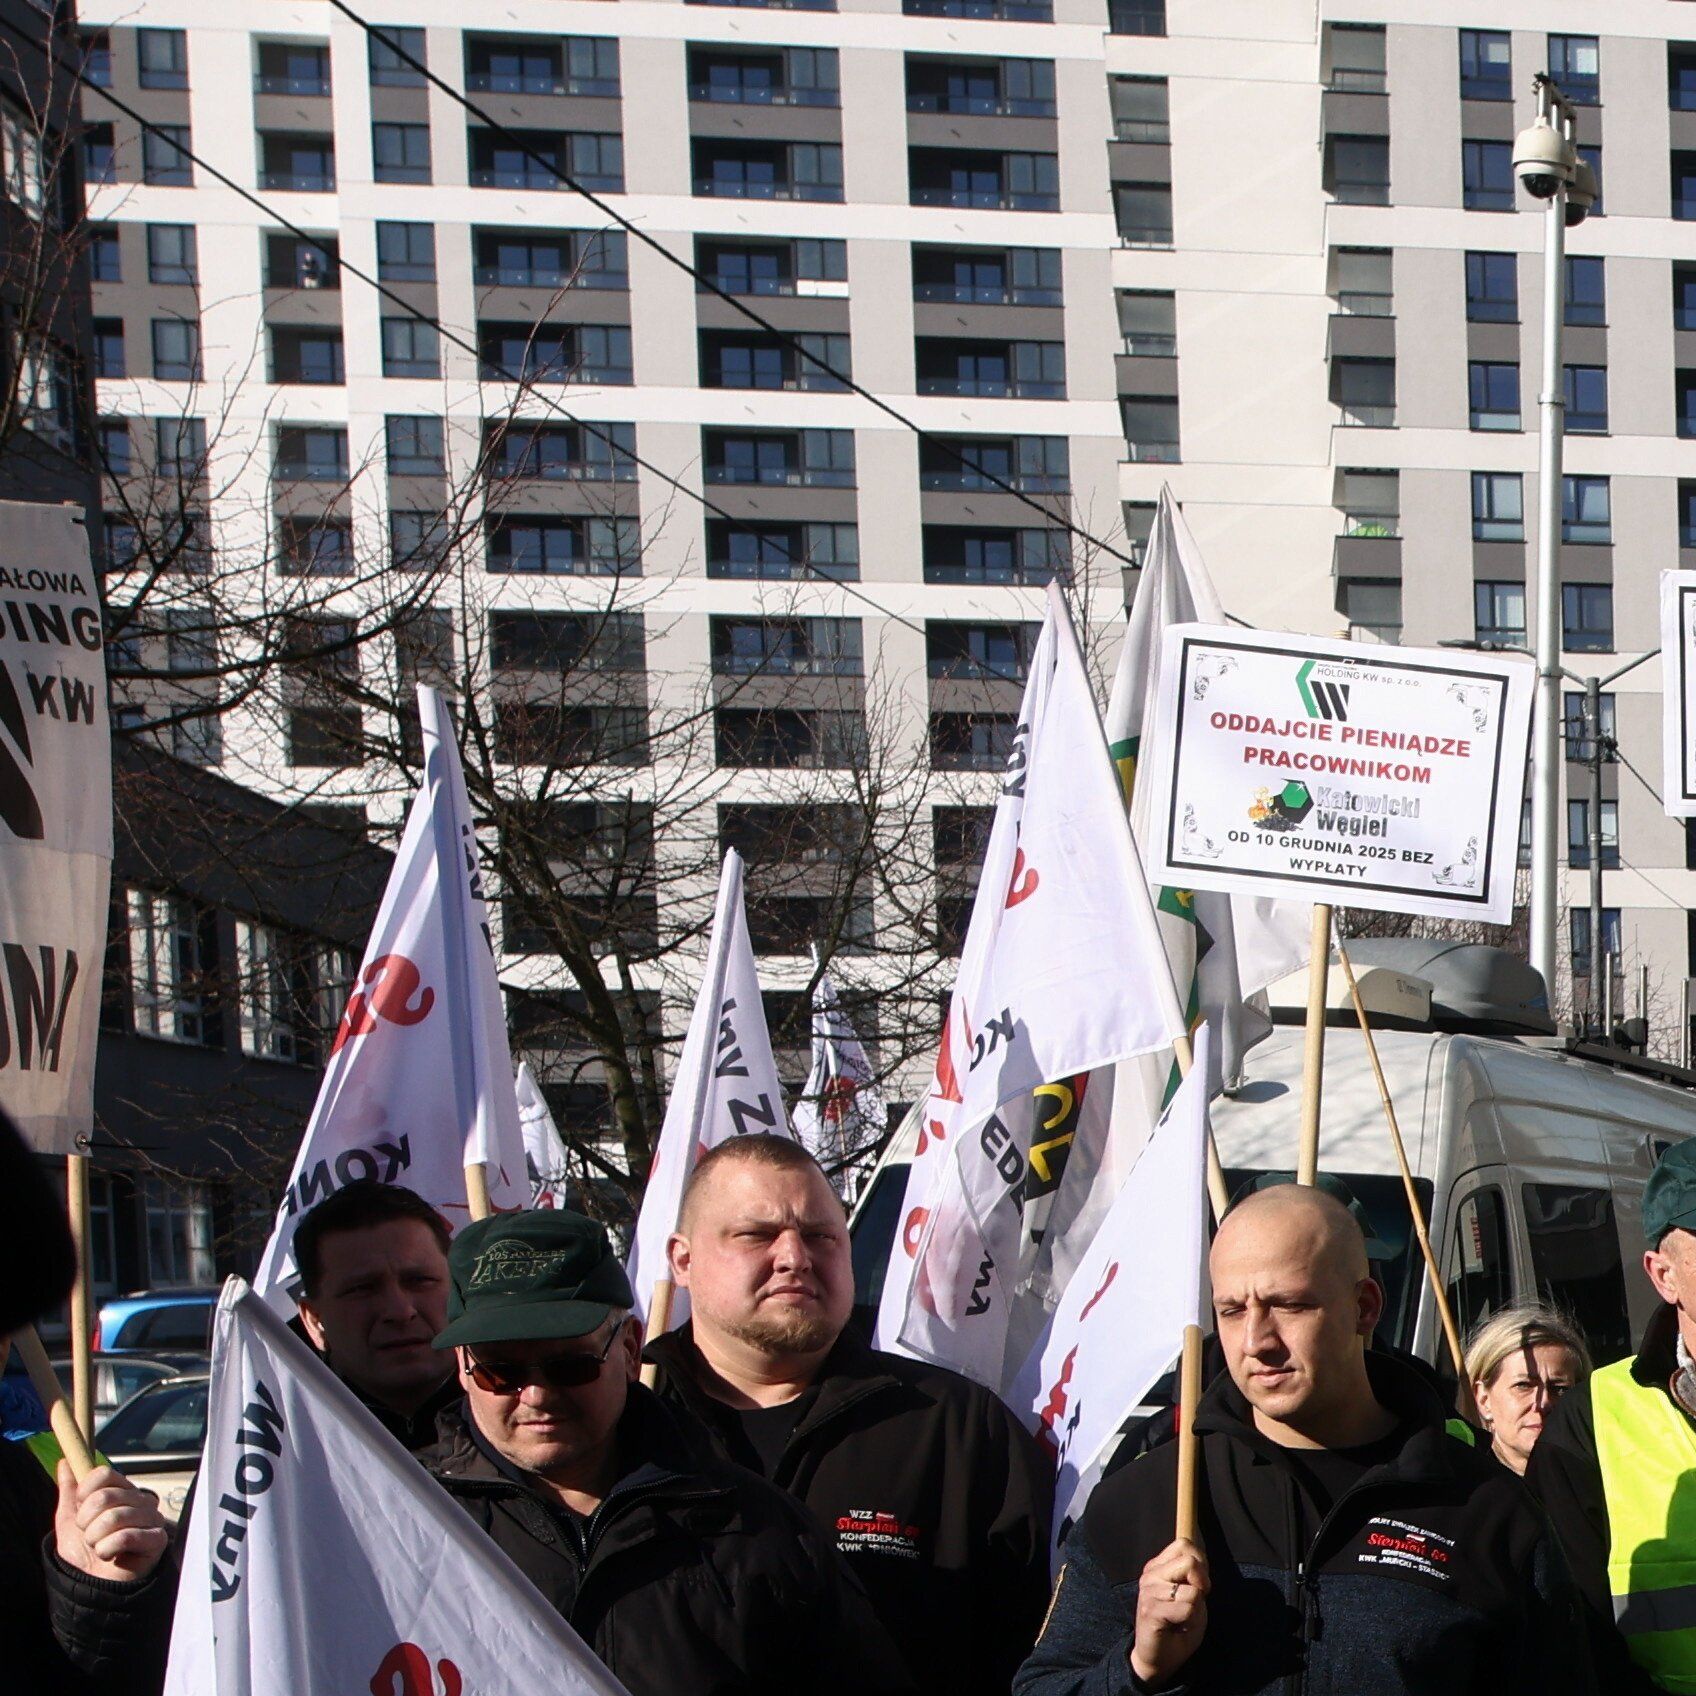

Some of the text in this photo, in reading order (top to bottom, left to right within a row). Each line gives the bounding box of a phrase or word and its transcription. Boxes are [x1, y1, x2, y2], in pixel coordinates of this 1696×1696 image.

[1317, 667, 1360, 681] HOLDING
[26, 662, 95, 727] KW
[1210, 711, 1471, 758] ODDAJCIE PIENIĄDZE
[1243, 746, 1432, 784] PRACOWNIKOM
[1316, 785, 1421, 819] Katowicki
[1316, 810, 1388, 839] Węgiel
[1228, 829, 1434, 865] OD 10 GRUDNIA 2025 BEZ
[1289, 856, 1367, 878] WYPŁATY
[849, 1509, 873, 1519] WZZ
[836, 1542, 863, 1552] KWK
[840, 1532, 915, 1547] KONFEDERACJA
[1358, 1554, 1378, 1563] KWK
